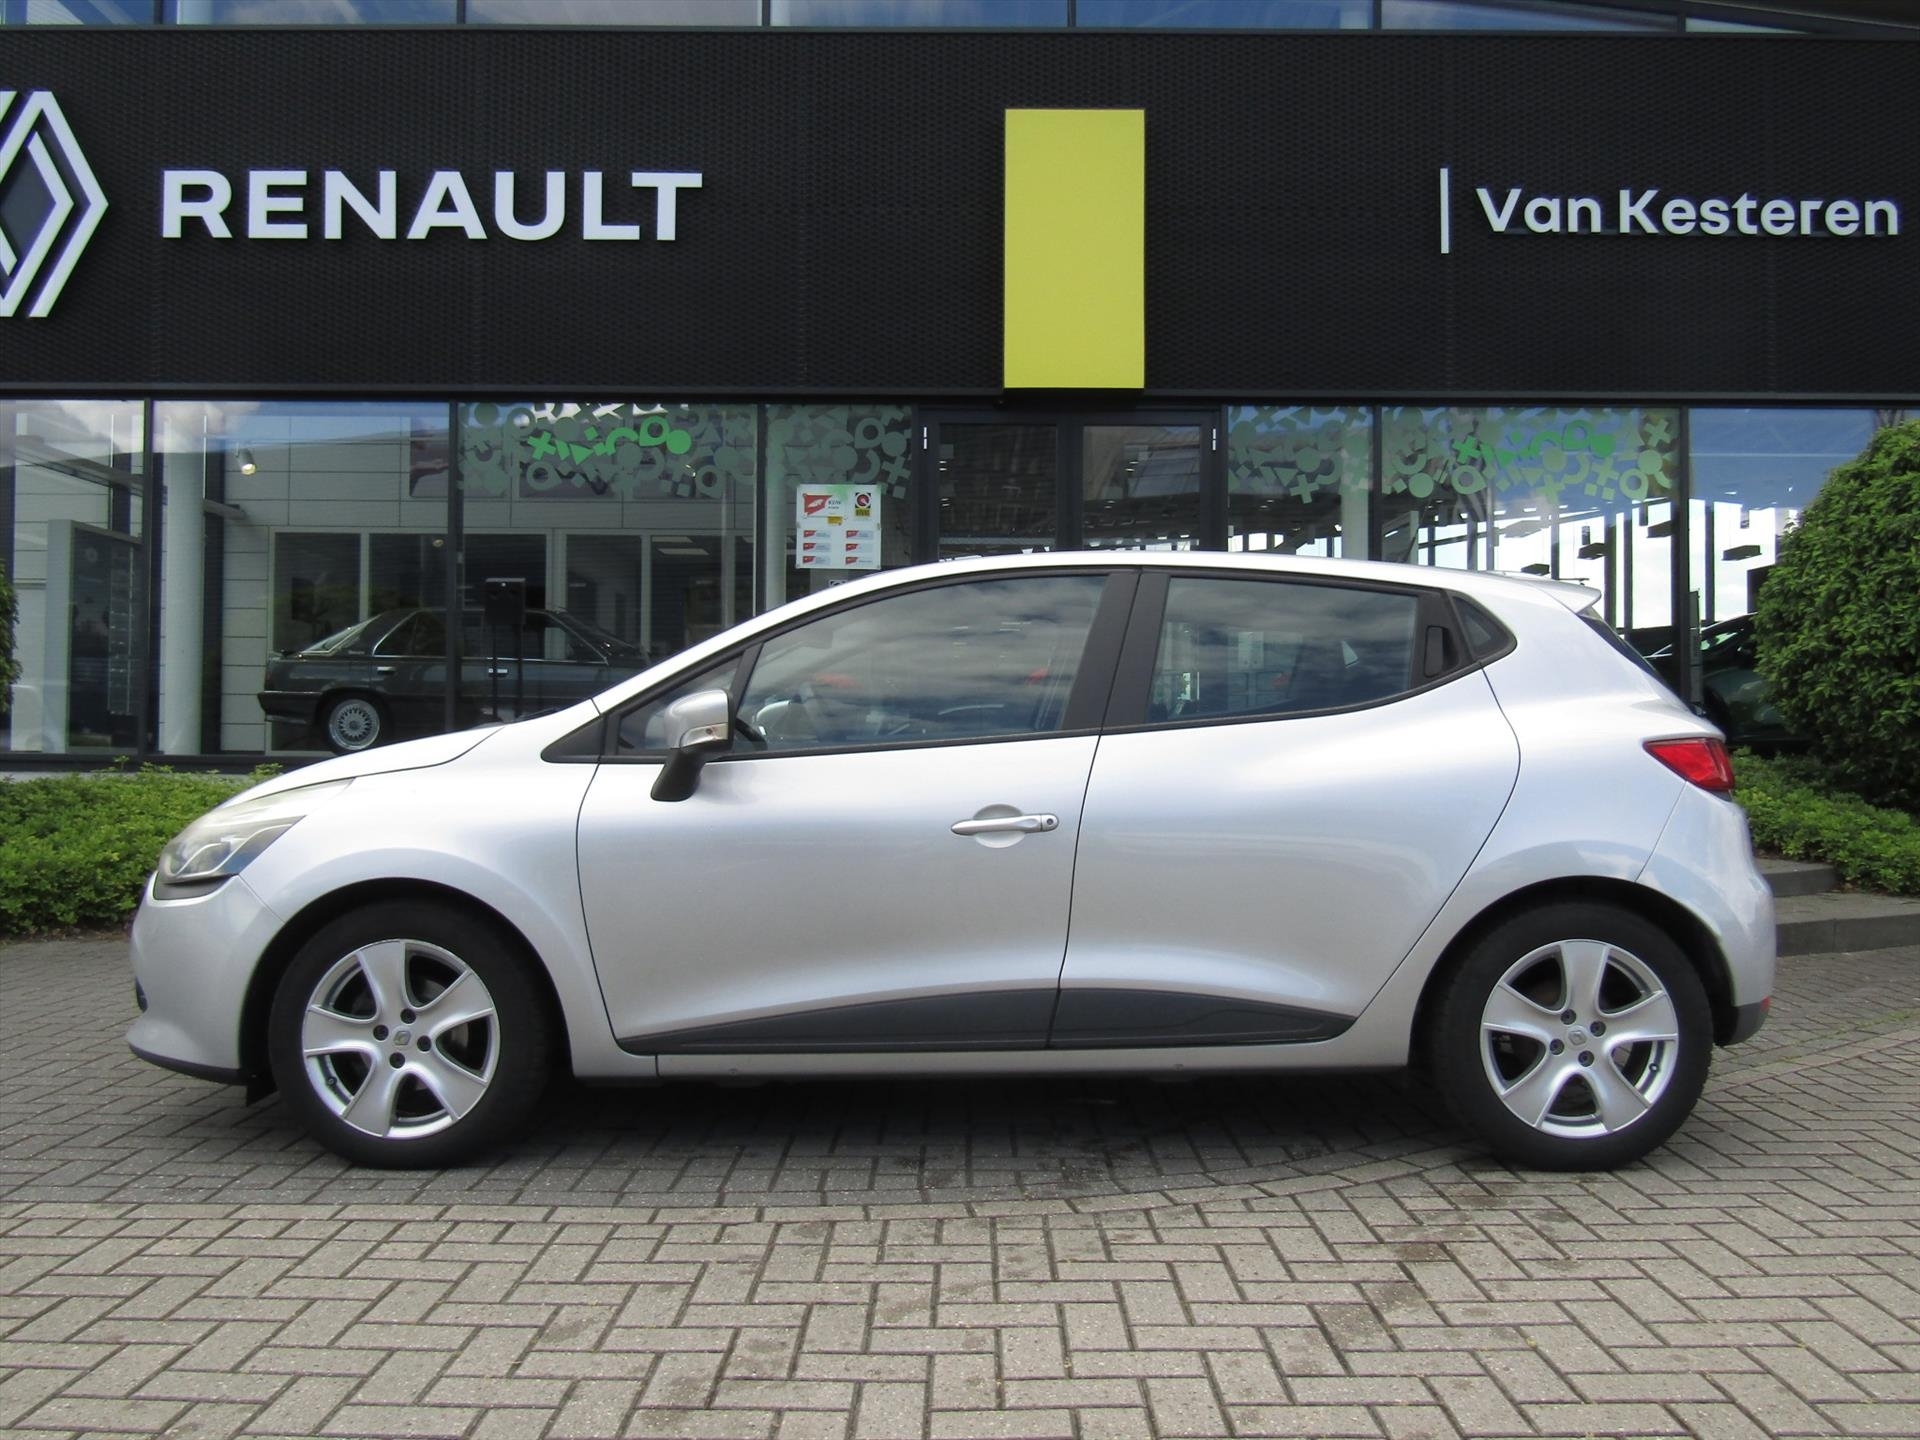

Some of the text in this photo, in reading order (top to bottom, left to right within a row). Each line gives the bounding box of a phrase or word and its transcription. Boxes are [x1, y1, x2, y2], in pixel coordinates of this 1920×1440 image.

[161, 170, 703, 242] RENAULT
[1476, 188, 1900, 237] Van Kesteren
